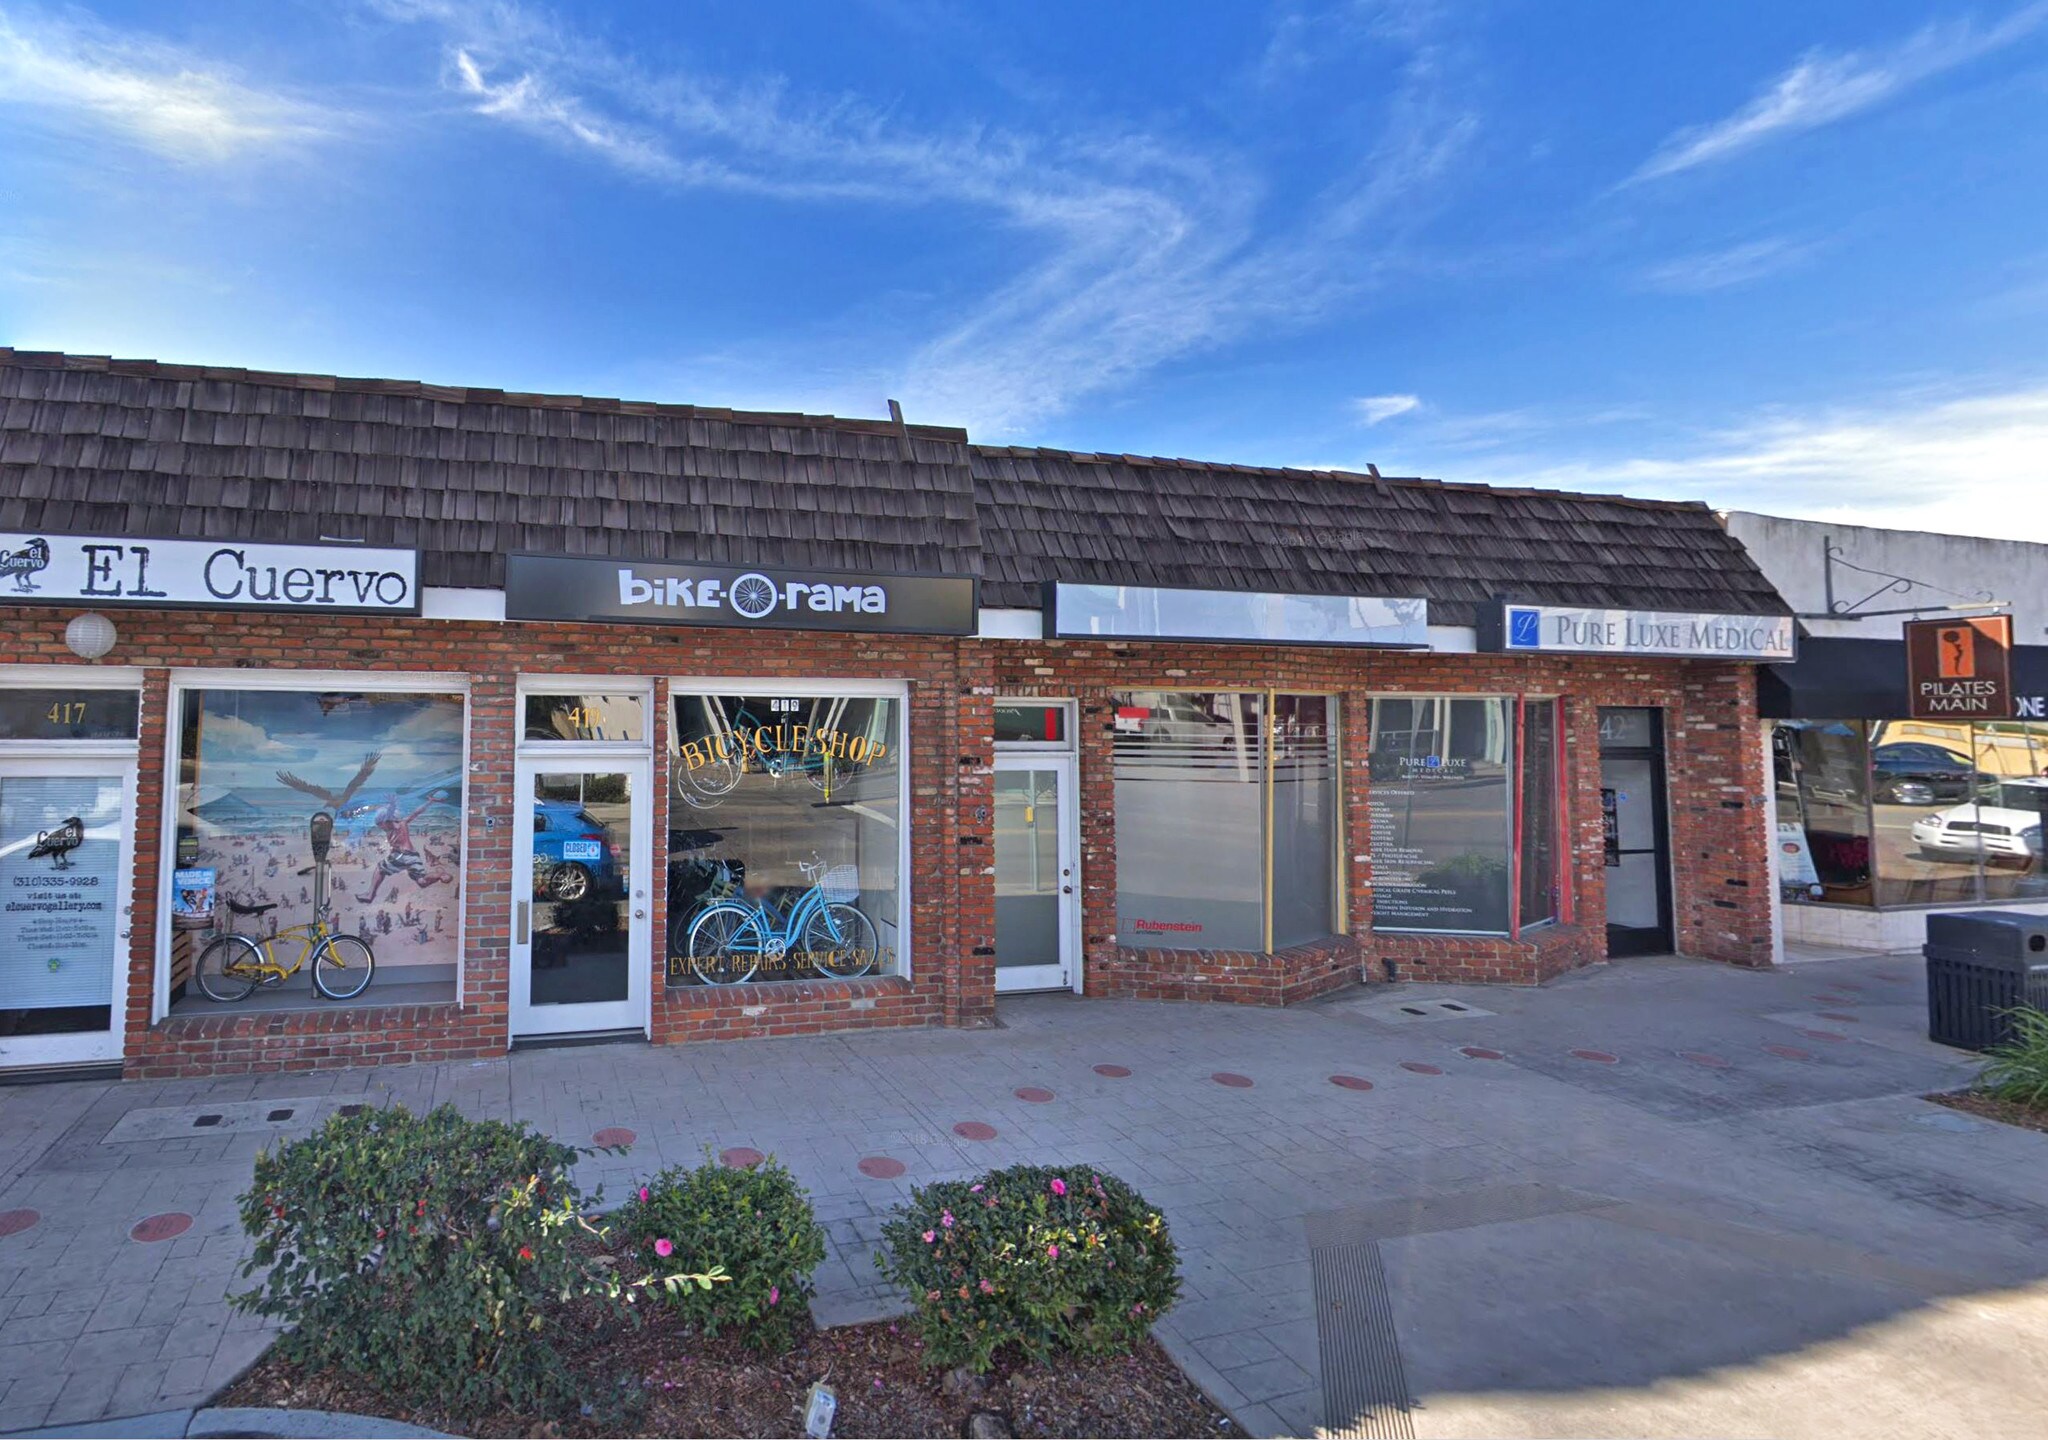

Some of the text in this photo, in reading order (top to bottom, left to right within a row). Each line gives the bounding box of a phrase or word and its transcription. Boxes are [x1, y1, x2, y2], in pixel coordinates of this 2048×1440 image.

[30, 547, 41, 558] el
[80, 545, 407, 605] El Cuervo
[1557, 616, 1788, 651] PURE LUXE MEDICAL
[1921, 681, 1997, 696] PILATES
[772, 701, 799, 711] 419
[1930, 698, 1988, 711] MAIN
[48, 702, 86, 724] 417
[1400, 757, 1466, 767] PURE LUXE
[565, 843, 587, 853] CLOSED
[5, 901, 102, 913] elcuervogallery.com
[1136, 919, 1203, 932] Rubenstein
